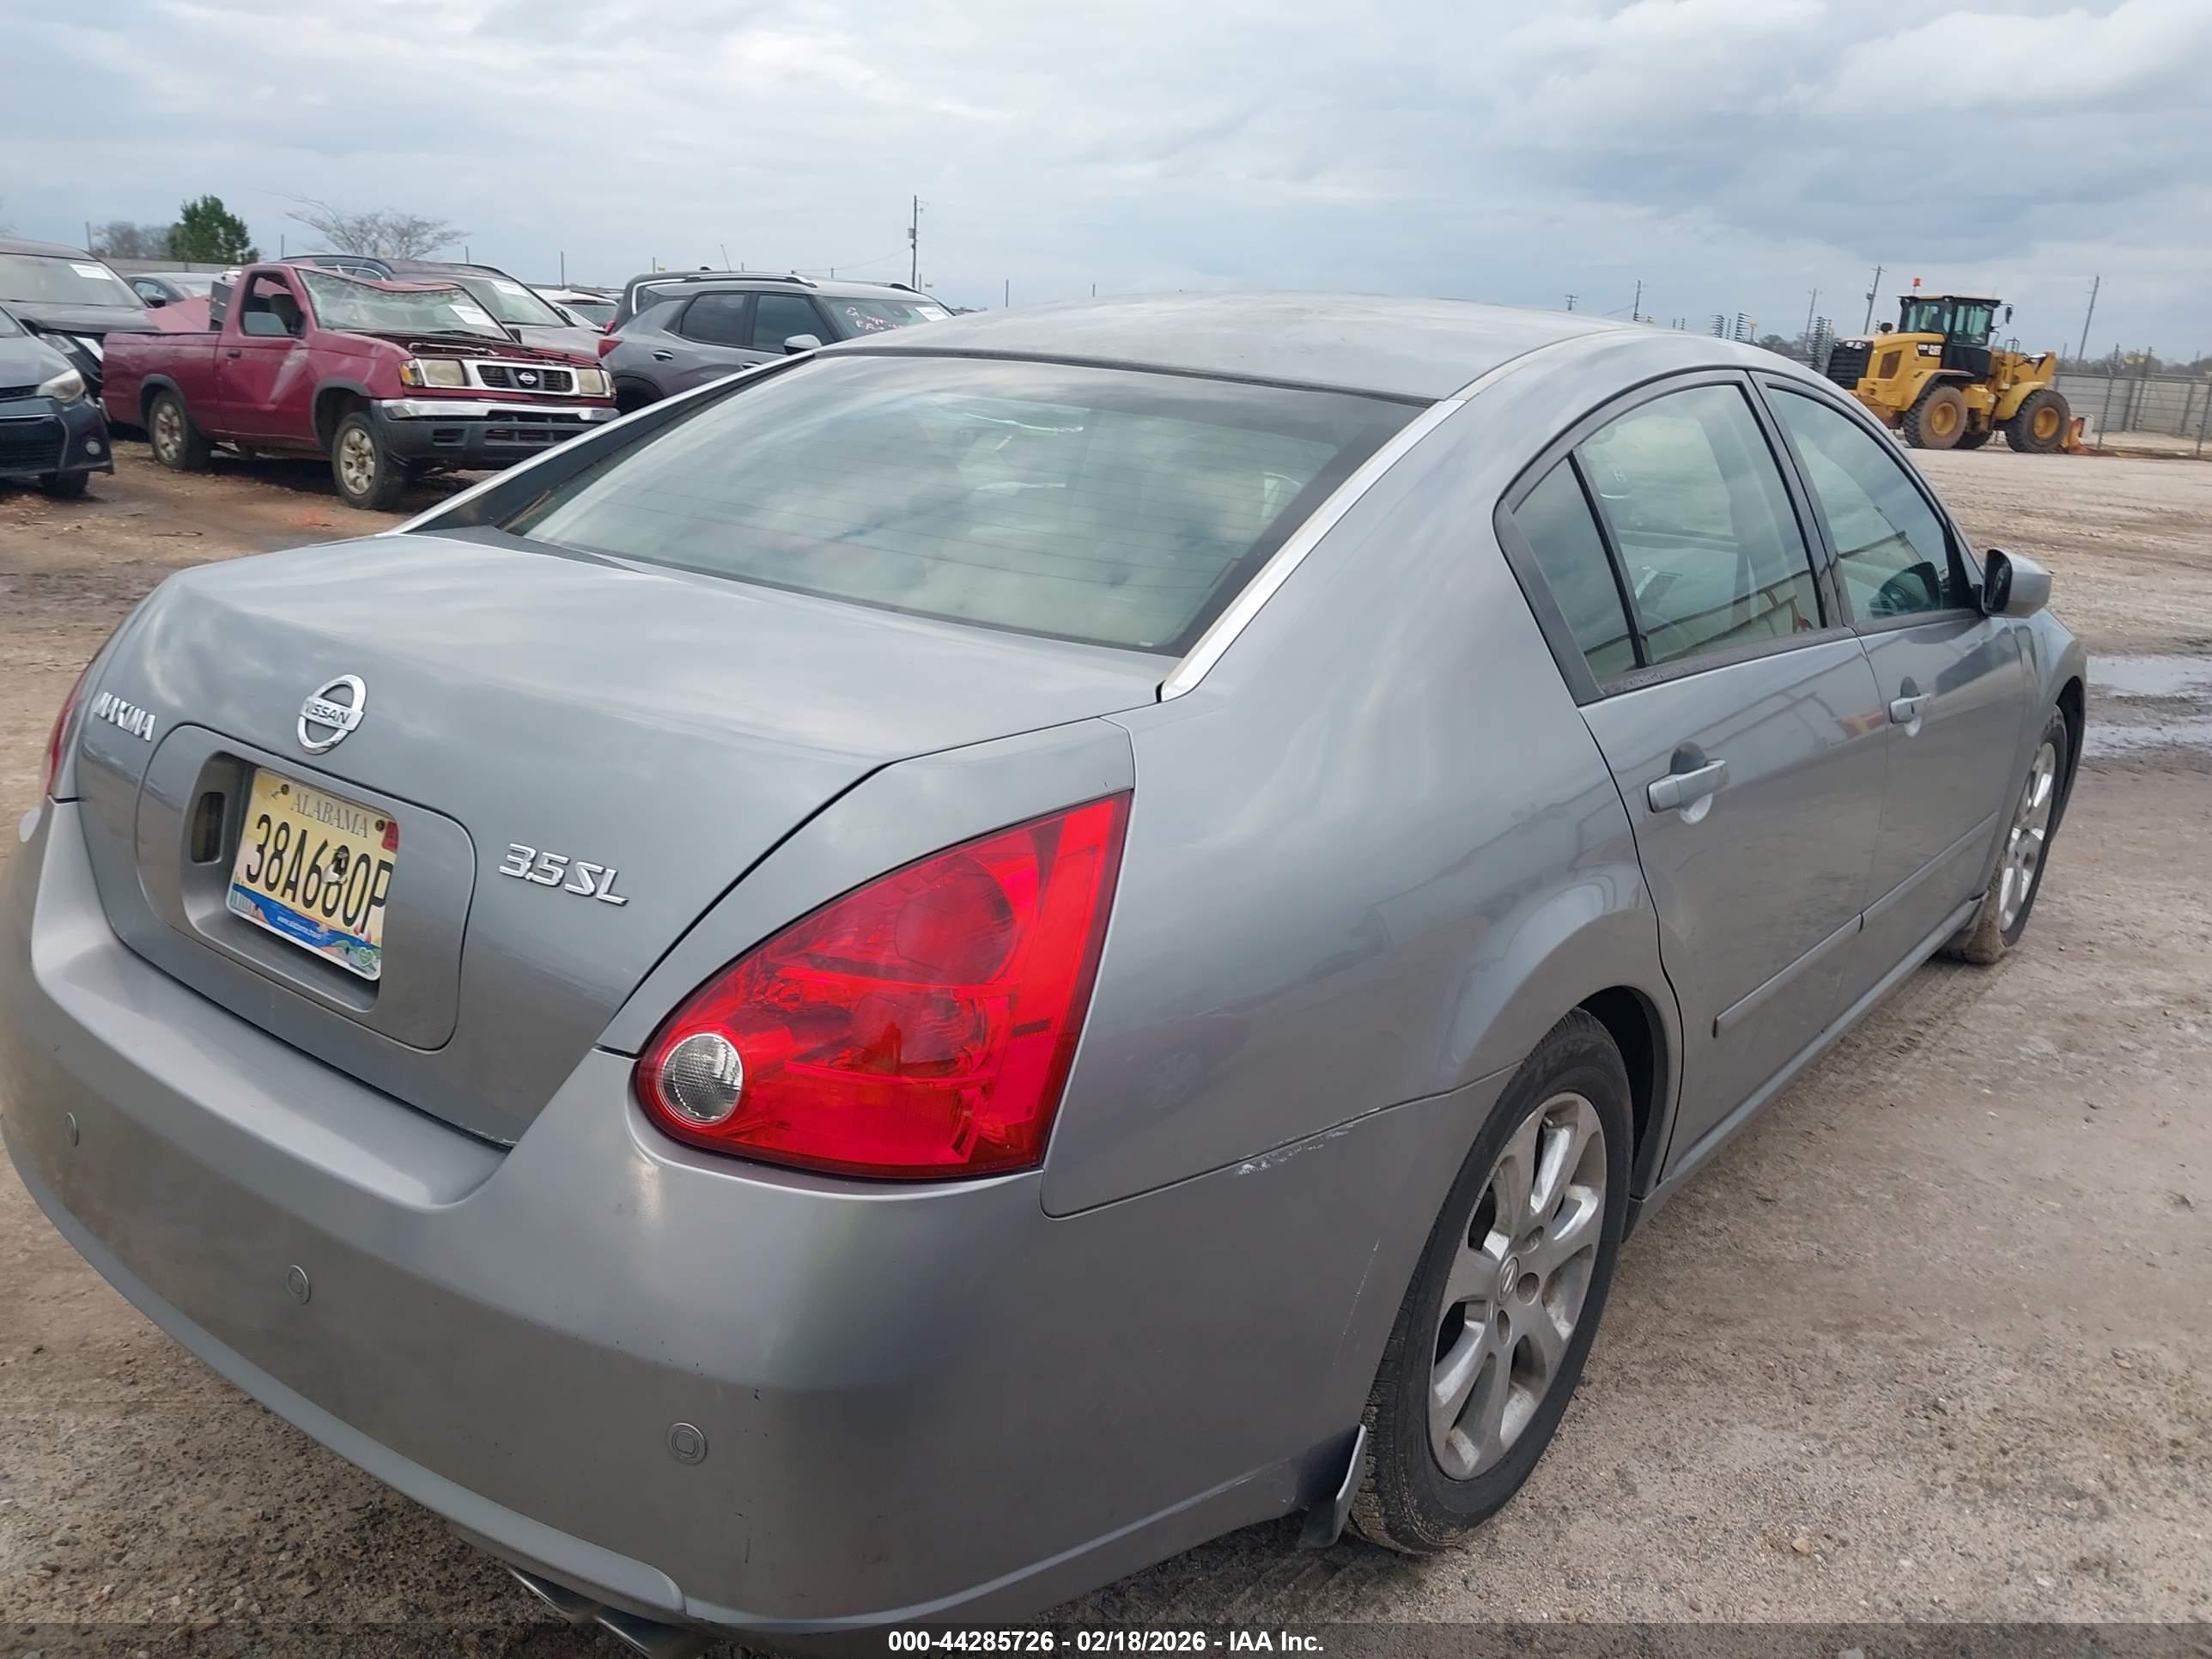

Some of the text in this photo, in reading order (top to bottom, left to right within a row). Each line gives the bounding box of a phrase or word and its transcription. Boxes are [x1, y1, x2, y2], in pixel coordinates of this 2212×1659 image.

[290, 792, 368, 839] ALABAMA
[246, 813, 394, 933] 38A680P
[563, 861, 629, 906] SL
